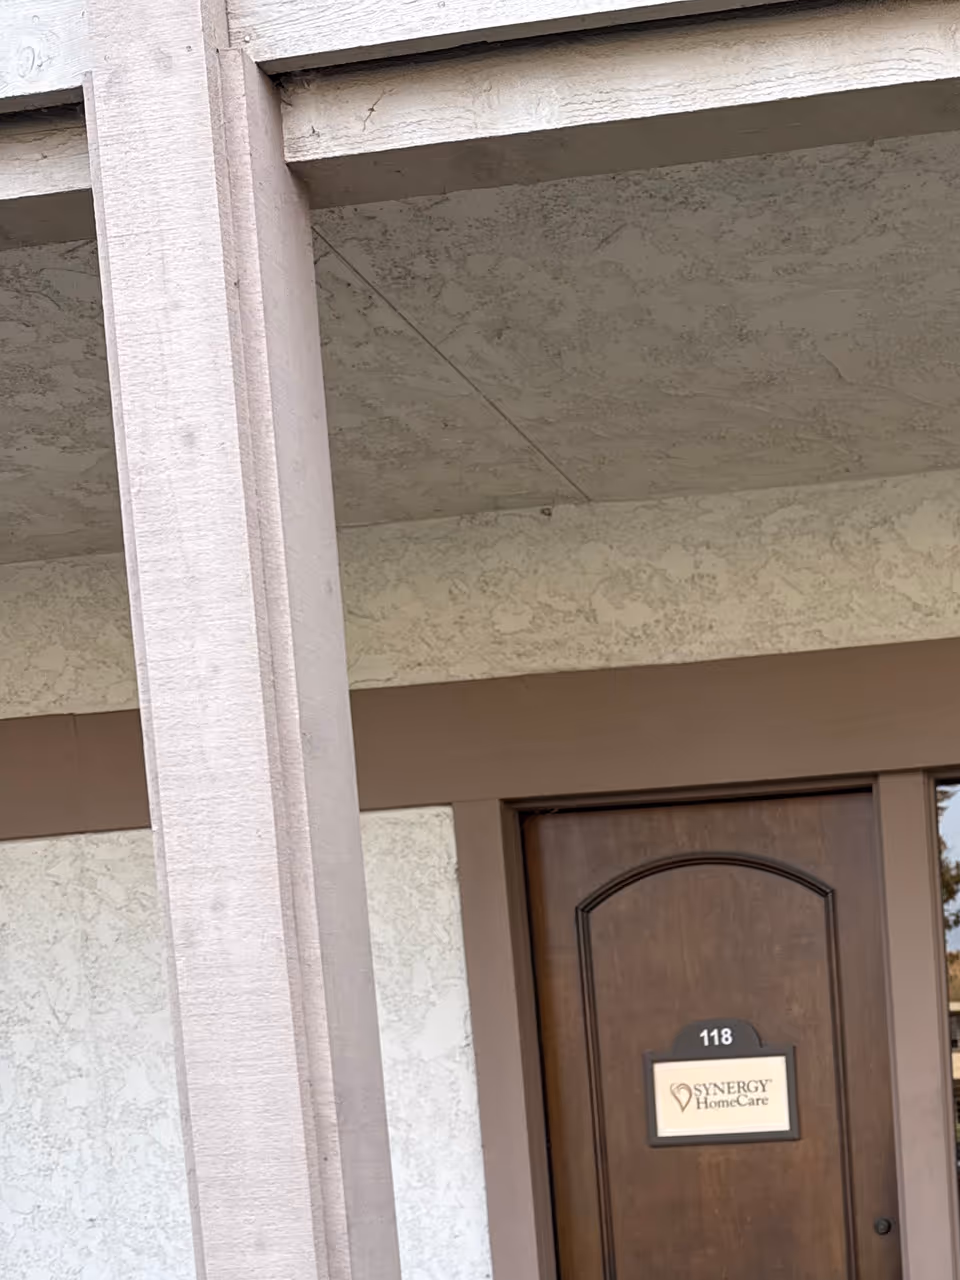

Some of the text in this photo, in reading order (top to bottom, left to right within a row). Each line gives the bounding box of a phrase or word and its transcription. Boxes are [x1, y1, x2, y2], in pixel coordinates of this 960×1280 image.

[699, 1028, 733, 1046] 118
[694, 1079, 770, 1097] SYNERGY
[696, 1094, 769, 1110] HomeCare
